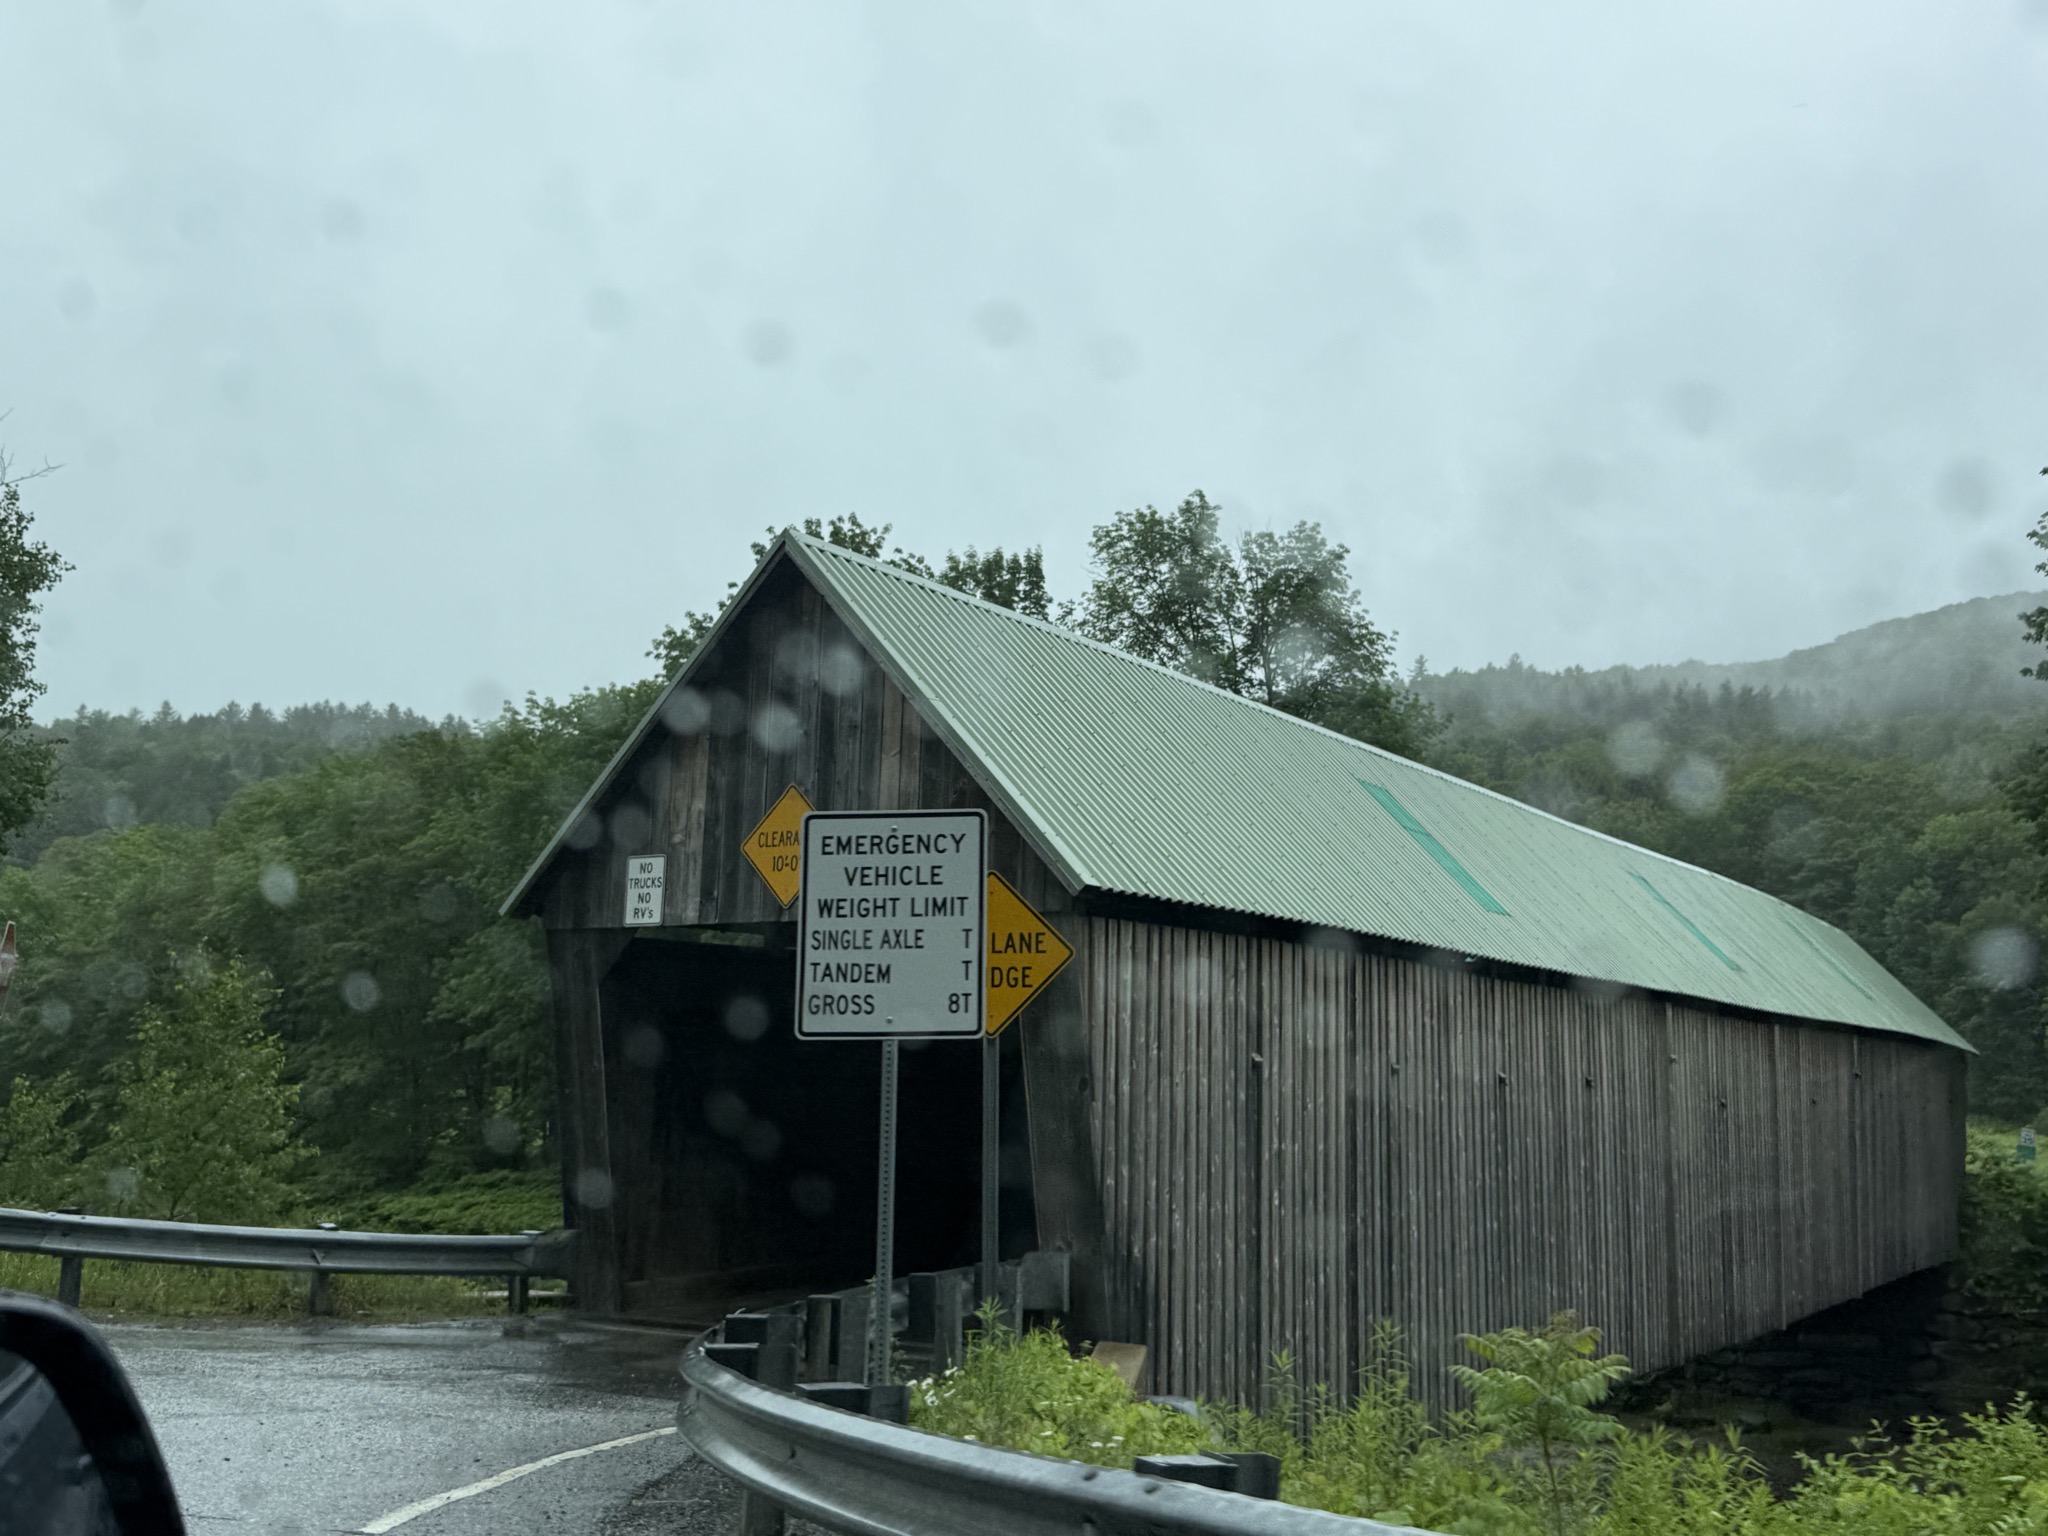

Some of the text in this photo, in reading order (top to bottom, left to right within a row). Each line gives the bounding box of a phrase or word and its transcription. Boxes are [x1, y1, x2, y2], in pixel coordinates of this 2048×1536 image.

[821, 833, 966, 855] EMERGENCY
[640, 862, 653, 874] NO
[844, 865, 943, 886] VEHICLE
[629, 877, 662, 889] TRUCKS
[638, 892, 651, 904] NO
[818, 897, 968, 918] WEIGHT LIMIT
[633, 907, 653, 919] RV's
[811, 929, 972, 950] SINGLE AXLE T
[991, 932, 1046, 953] LANE
[810, 961, 972, 984] TANDEM T
[991, 966, 1033, 988] DGE
[808, 994, 972, 1015] GROSS 8T
